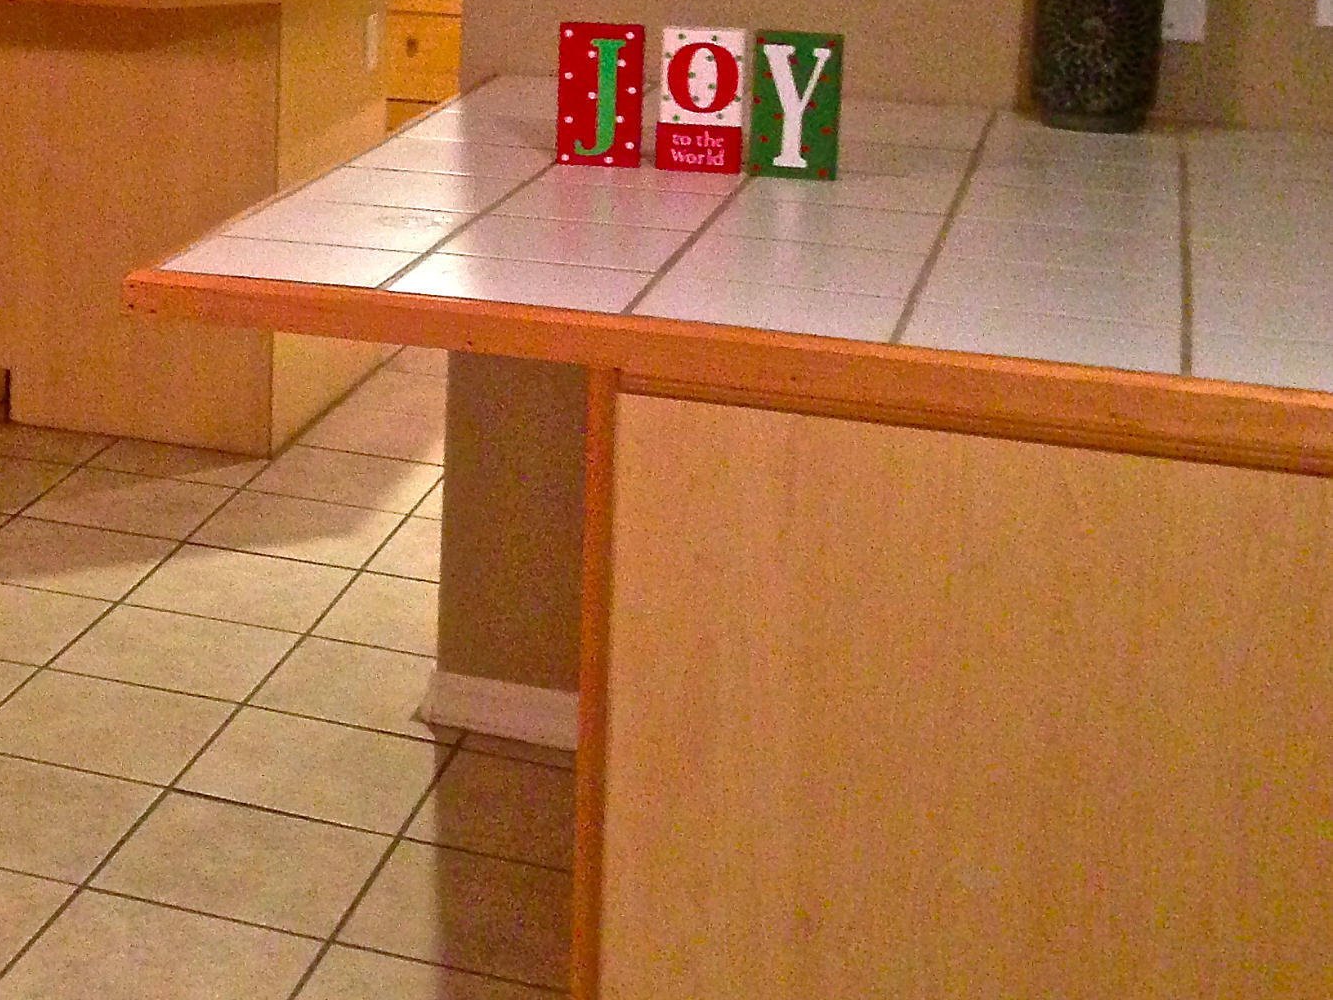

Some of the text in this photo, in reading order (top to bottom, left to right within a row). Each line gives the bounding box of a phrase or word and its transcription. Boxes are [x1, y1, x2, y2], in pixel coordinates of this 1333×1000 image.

[574, 38, 831, 168] JOY
[672, 130, 724, 147] to the
